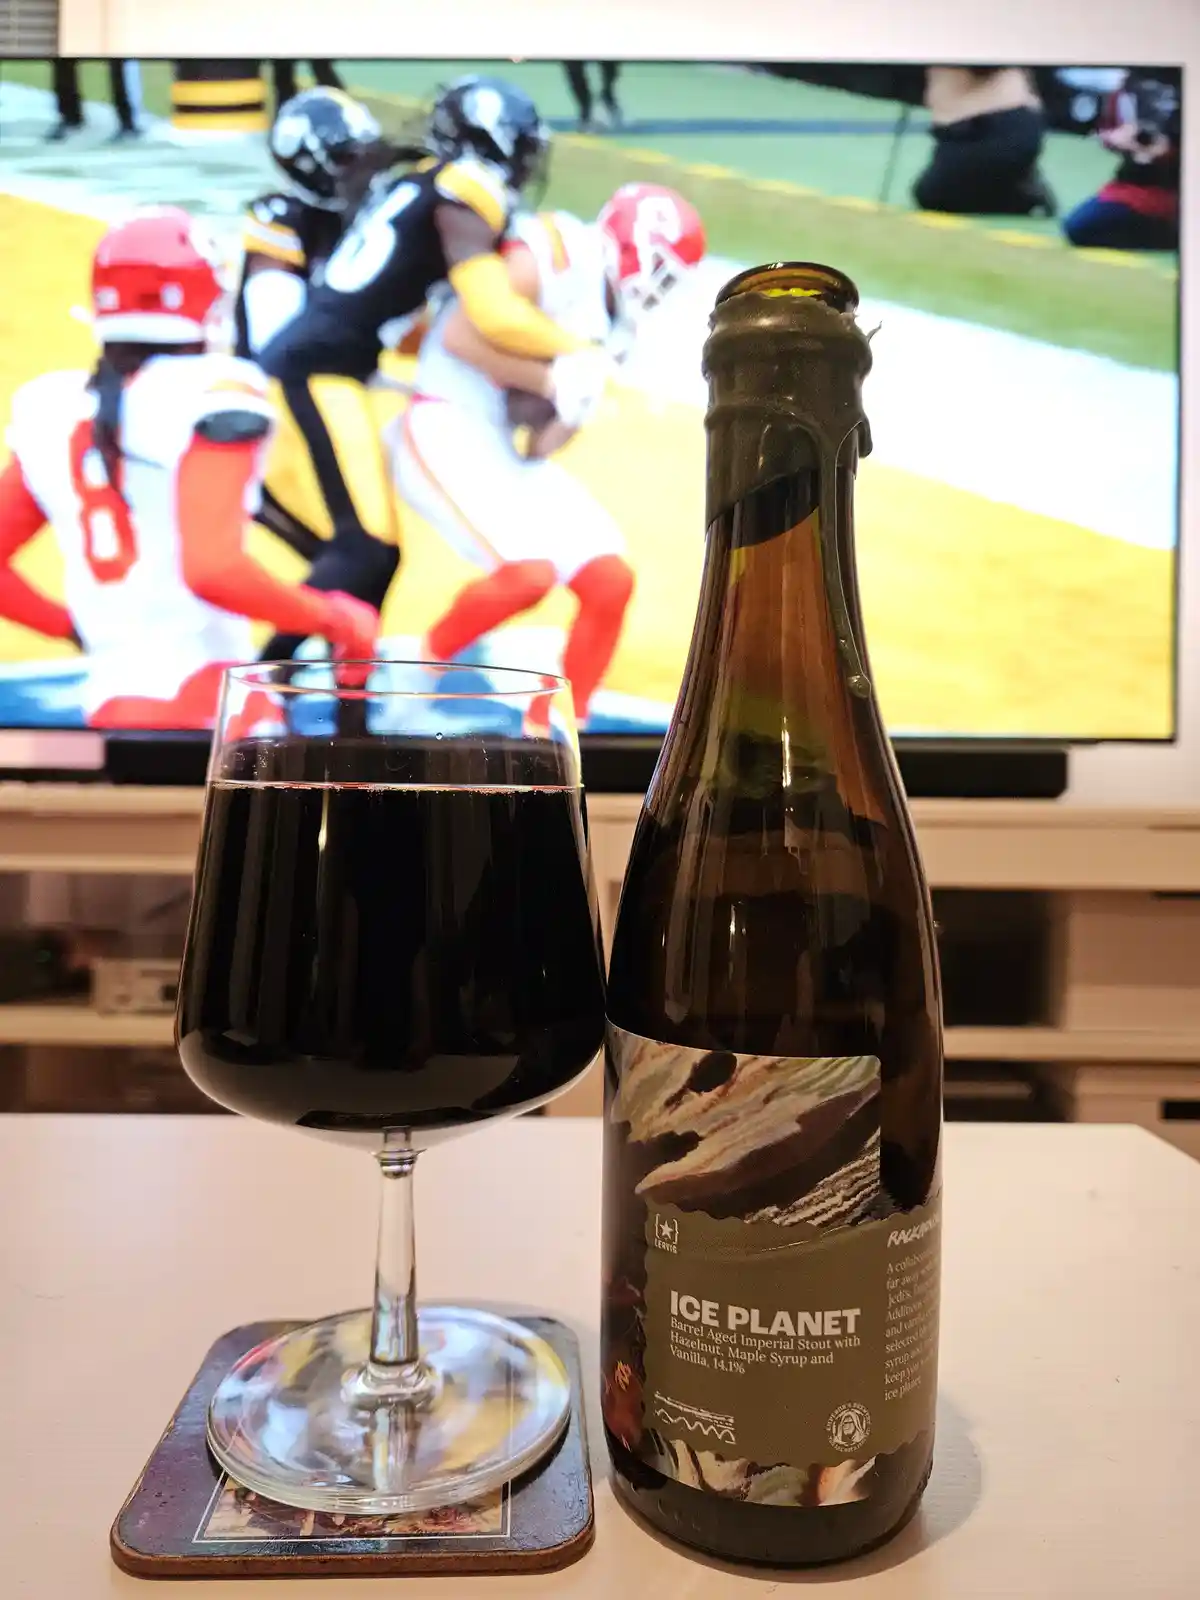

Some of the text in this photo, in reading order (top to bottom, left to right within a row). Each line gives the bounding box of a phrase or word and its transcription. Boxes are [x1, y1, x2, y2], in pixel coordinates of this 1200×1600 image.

[670, 1290, 861, 1337] ICE PLANET
[670, 1316, 861, 1351] Barrel Aged Imperial Stout with
[727, 1346, 768, 1365] Maple
[769, 1352, 808, 1368] Syrup
[810, 1352, 834, 1365] and
[884, 1372, 905, 1385] keep
[884, 1389, 898, 1401] ice
